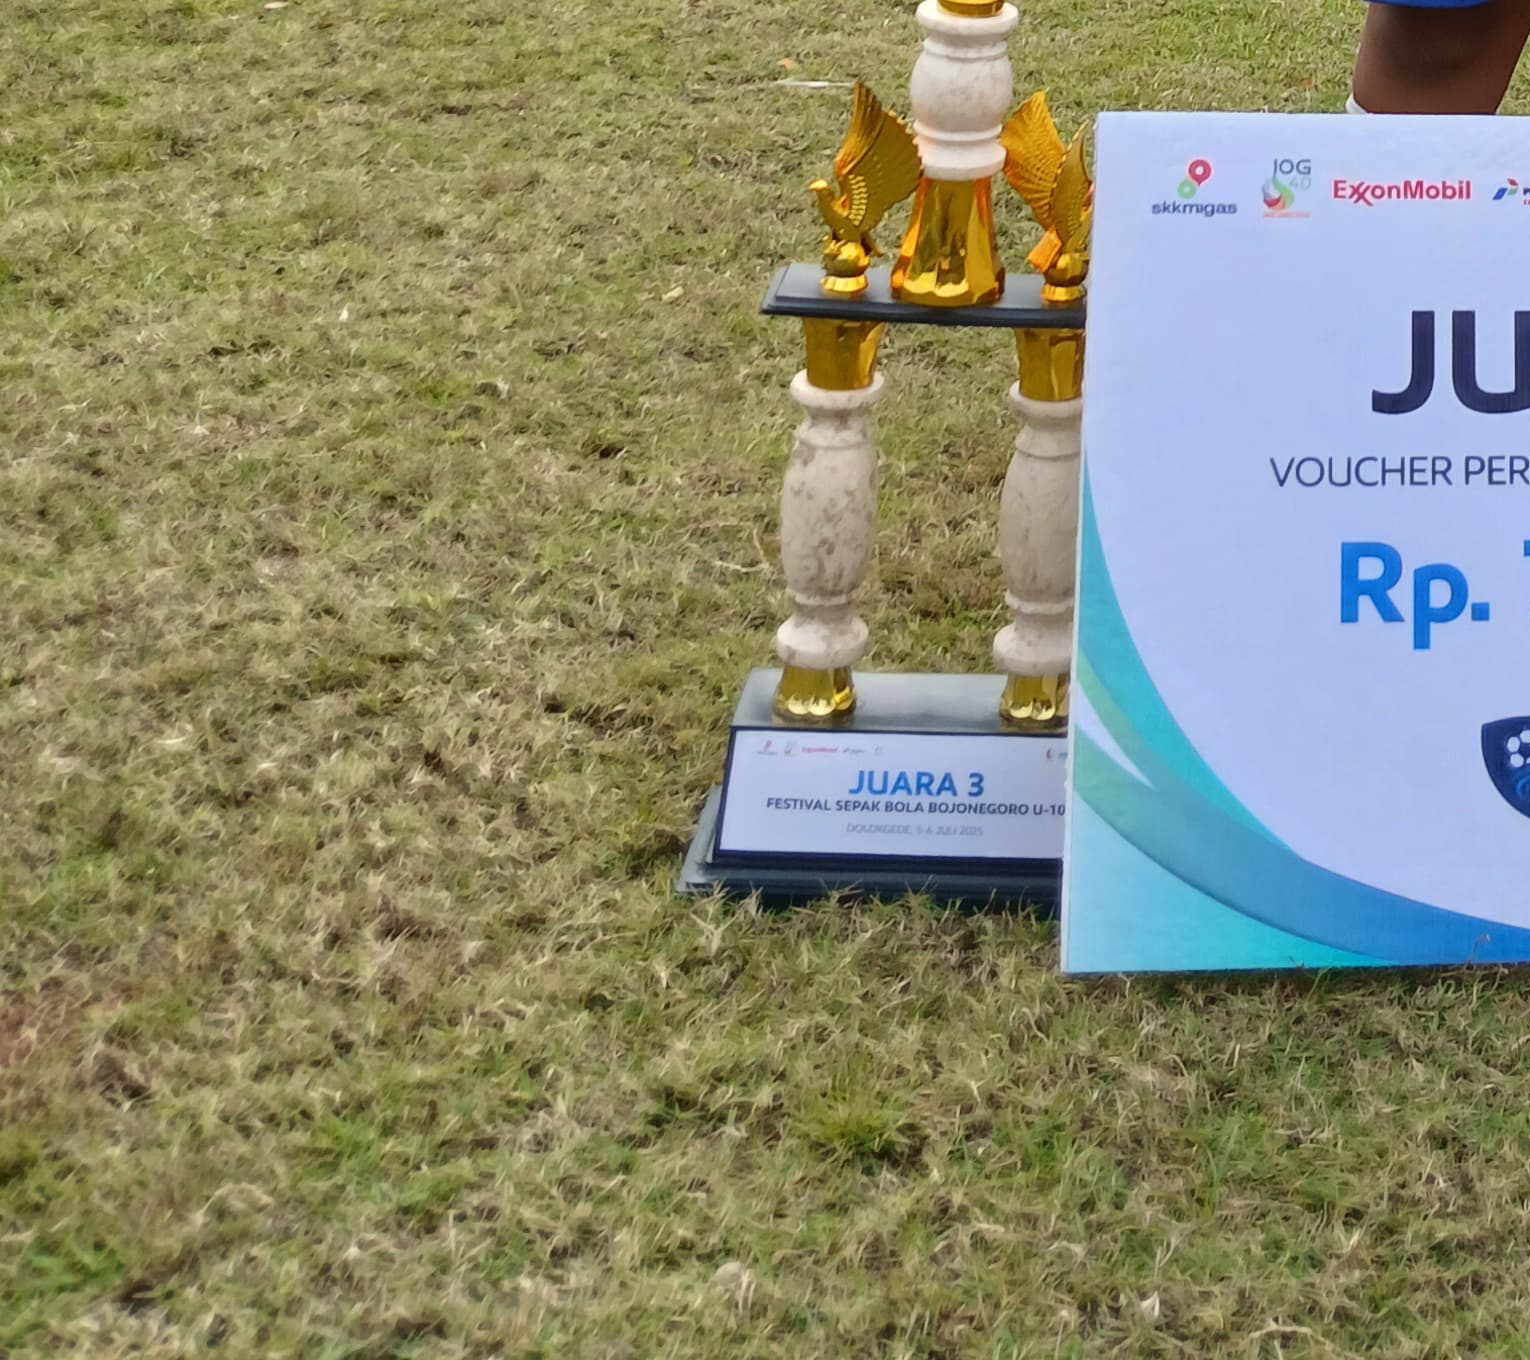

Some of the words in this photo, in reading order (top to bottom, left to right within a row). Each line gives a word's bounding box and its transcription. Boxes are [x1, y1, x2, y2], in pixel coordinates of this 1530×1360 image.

[1333, 179, 1472, 207] ExxonMobil
[1151, 200, 1238, 218] skkmigas
[1270, 455, 1453, 487] VOUCHER
[1340, 541, 1490, 649] Rp.
[848, 769, 958, 797] JUARA
[968, 772, 985, 798] 3
[766, 796, 831, 812] FESTIVAL
[835, 798, 880, 813] SEPAK
[884, 800, 924, 813] BOLA
[928, 801, 1029, 816] BOJONEGORO
[1032, 803, 1066, 816] U-10
